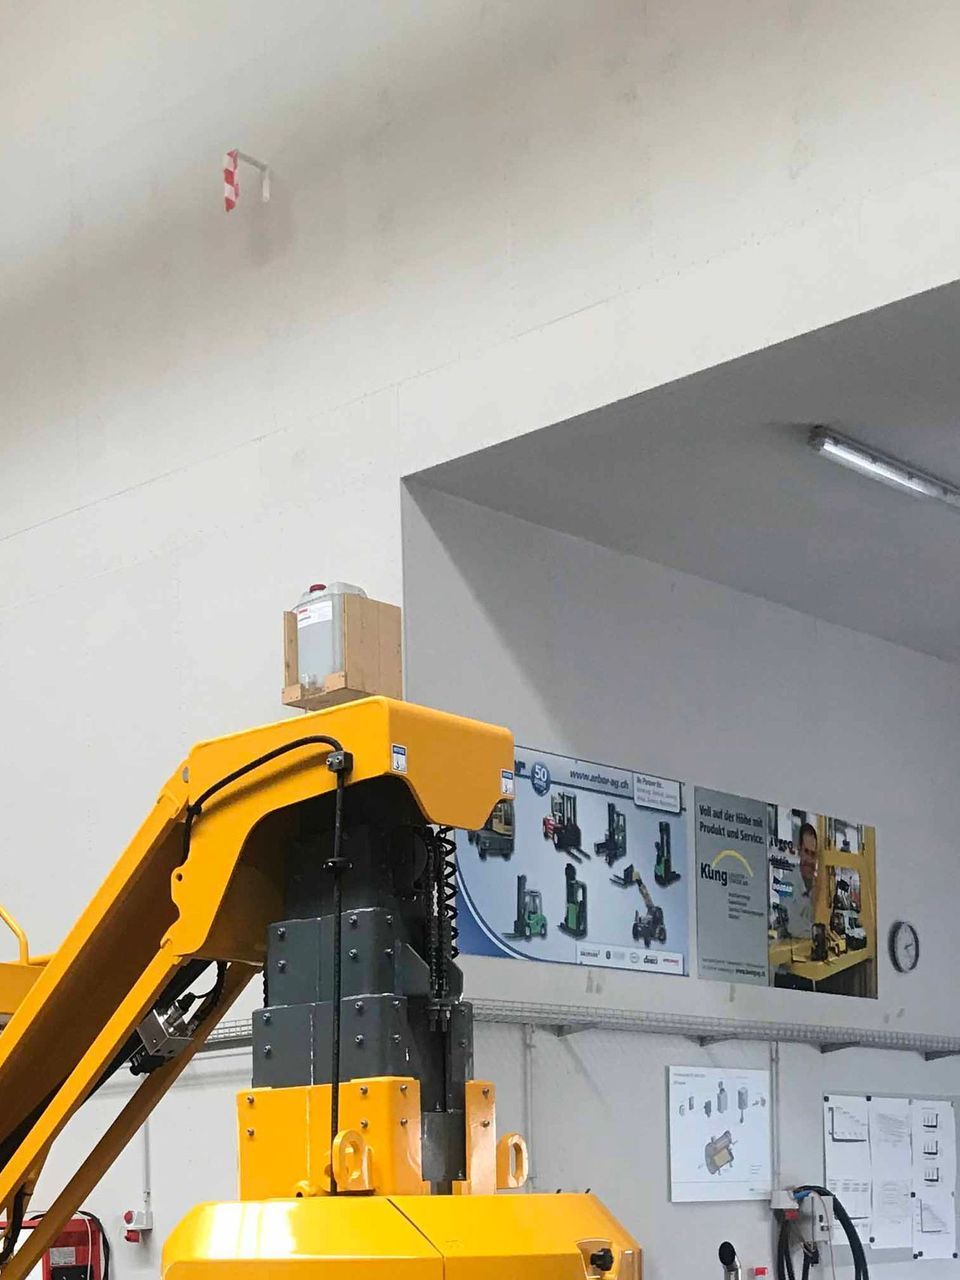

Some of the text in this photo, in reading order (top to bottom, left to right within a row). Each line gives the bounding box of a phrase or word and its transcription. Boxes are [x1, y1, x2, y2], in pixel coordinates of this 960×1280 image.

[534, 764, 548, 782] 50
[569, 769, 629, 790] www.arbor-ag.ch
[699, 804, 764, 828] Voll auf der Höhe mit
[699, 821, 765, 845] Produkt und Service.
